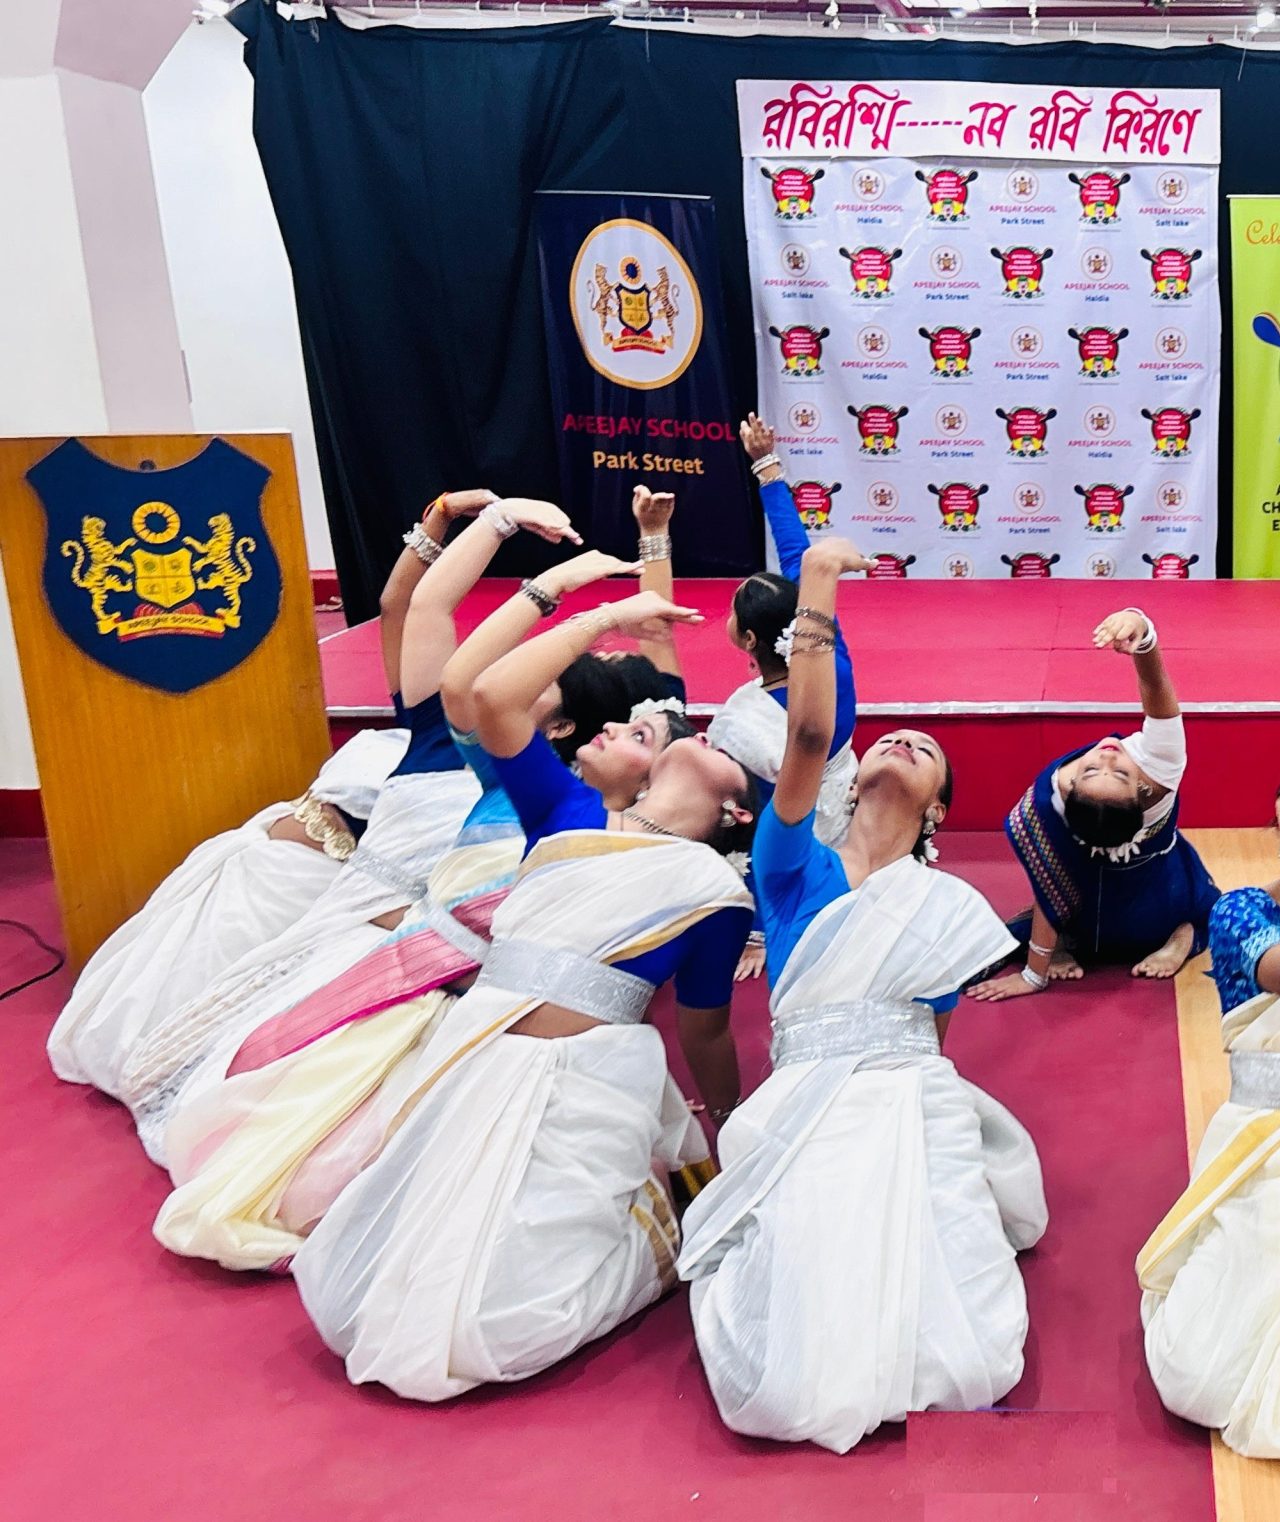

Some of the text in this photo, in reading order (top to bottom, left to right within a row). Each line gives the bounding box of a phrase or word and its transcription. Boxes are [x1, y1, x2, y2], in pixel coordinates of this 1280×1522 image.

[1029, 90, 1093, 152] রবি
[1102, 90, 1202, 155] কিরণে
[647, 419, 736, 441] SCHOOL
[592, 451, 704, 474] Park Street
